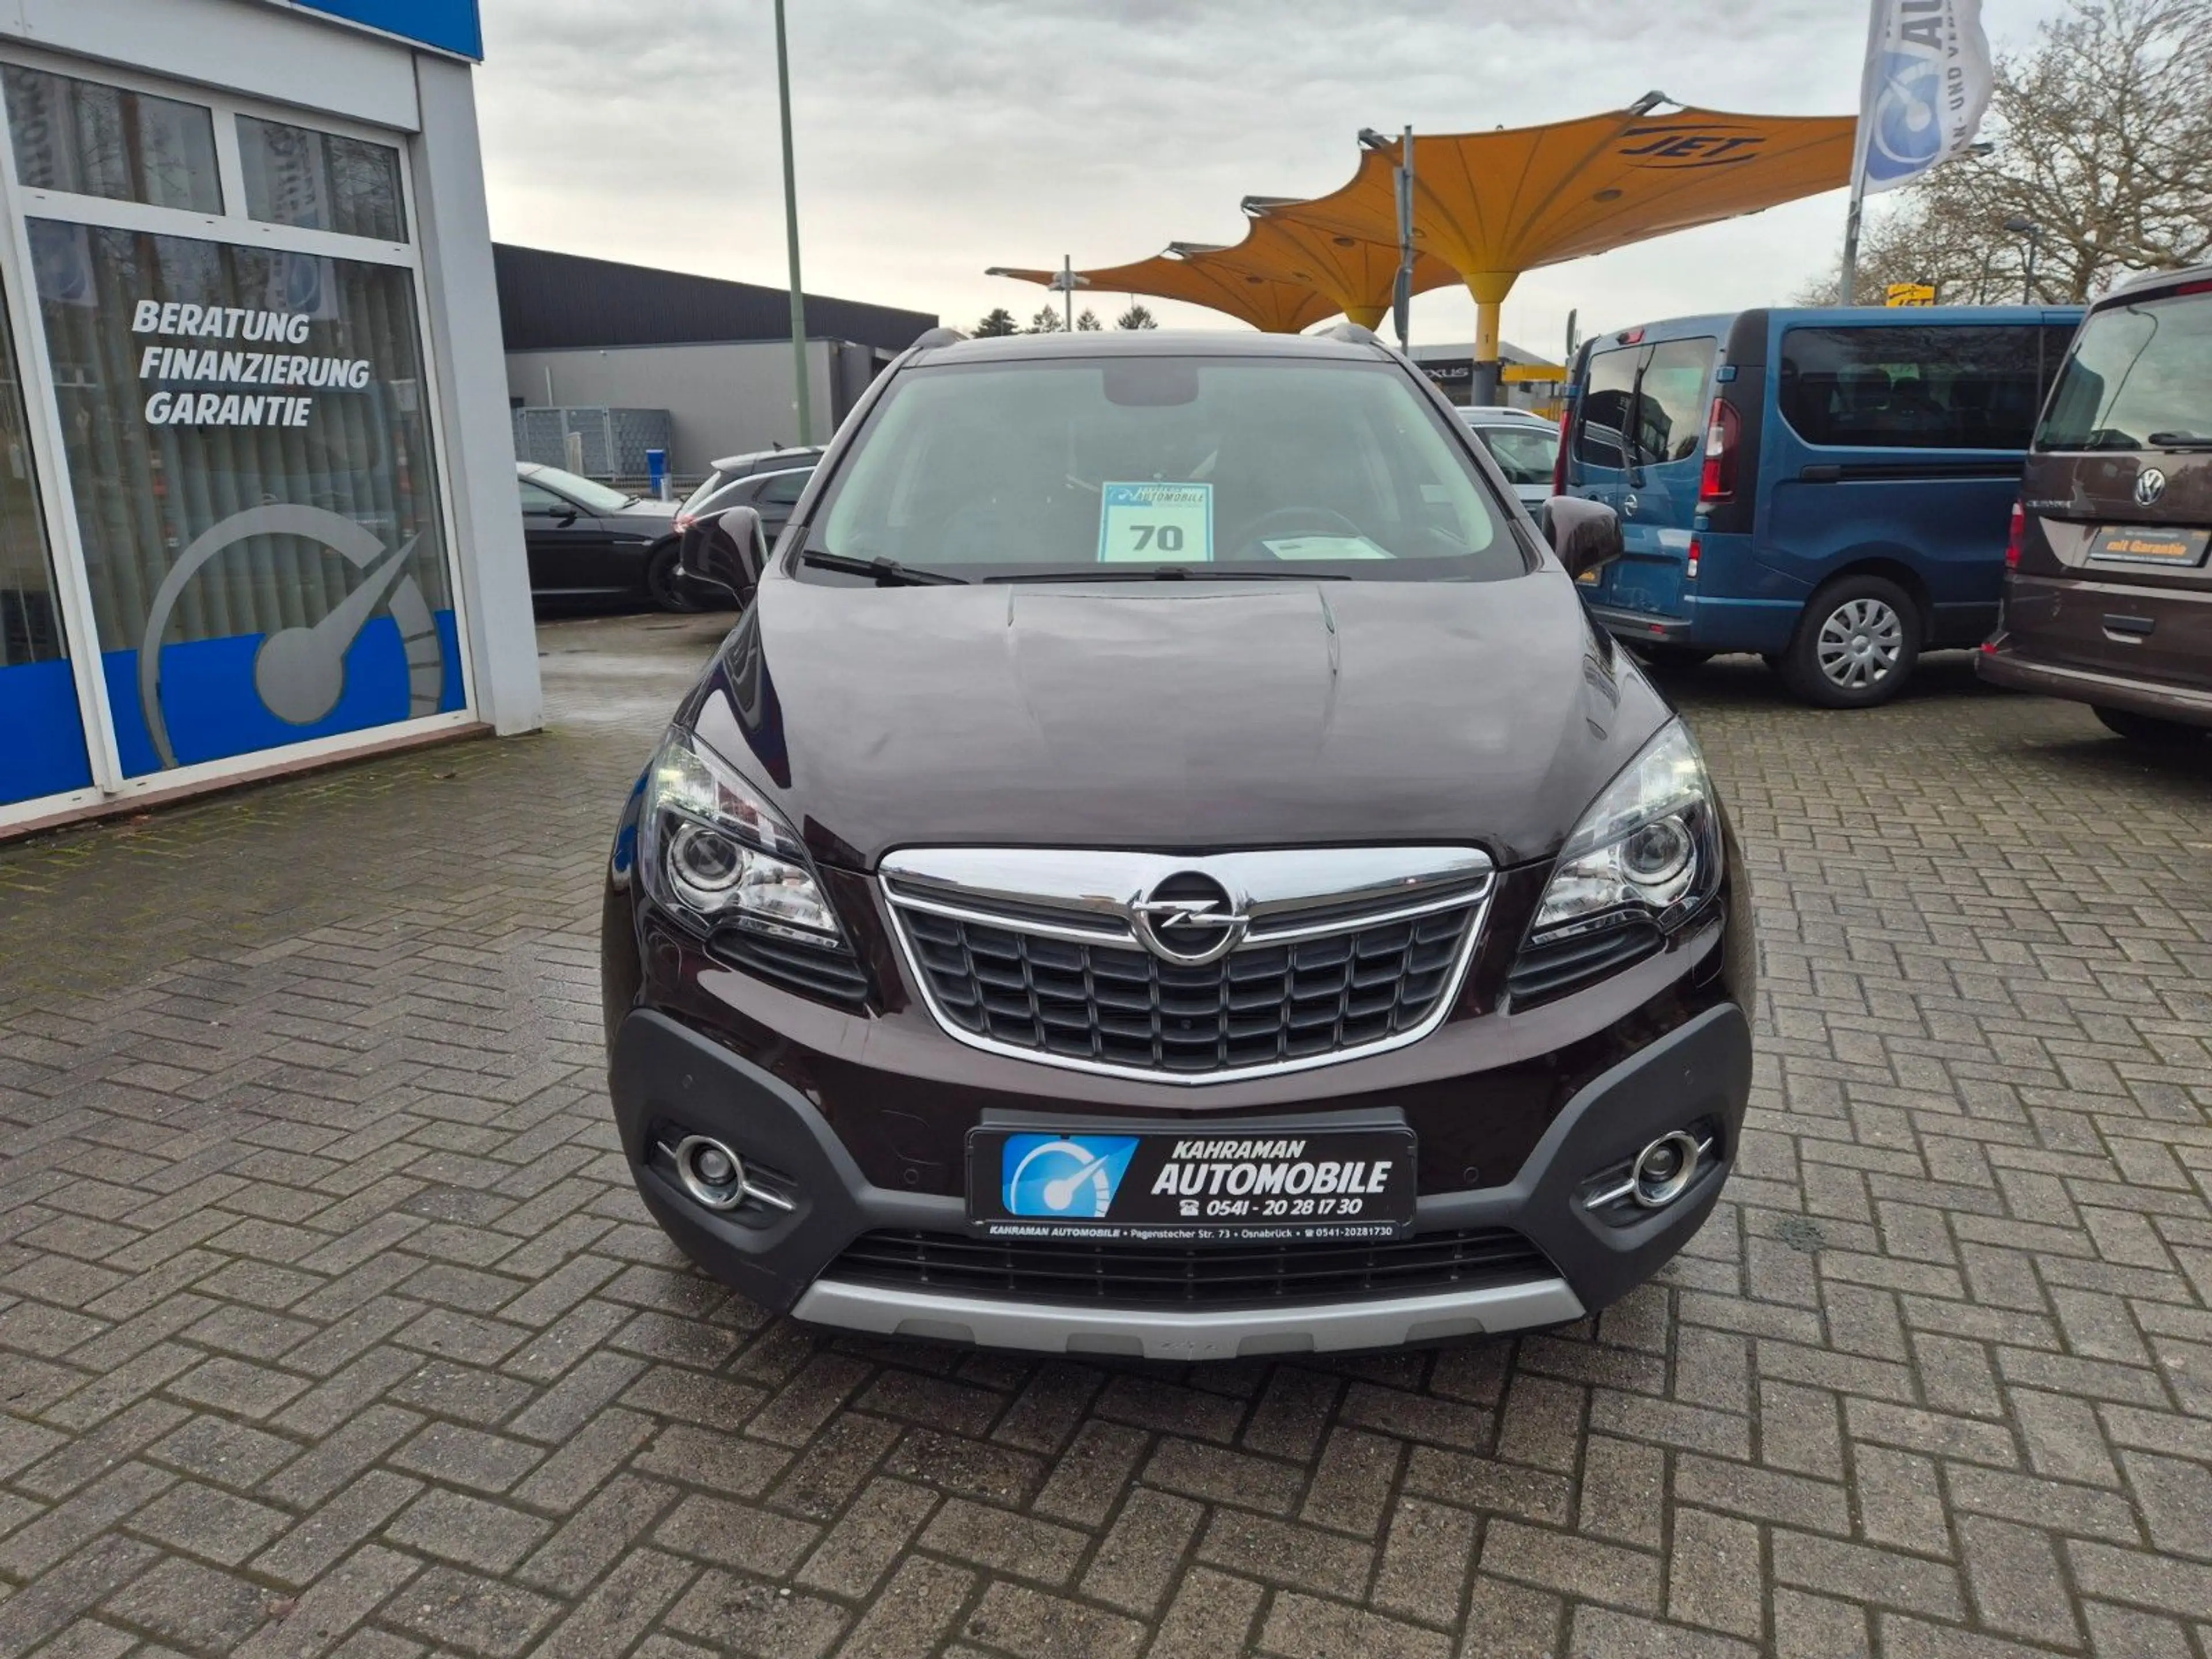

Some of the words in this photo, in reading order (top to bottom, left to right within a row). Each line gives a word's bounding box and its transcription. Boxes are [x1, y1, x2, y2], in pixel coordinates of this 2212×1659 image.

[1948, 67, 1965, 111] UND
[1618, 135, 1767, 157] JET
[132, 300, 310, 344] BERATUNG
[139, 346, 370, 389] FINANZIERUNG
[145, 391, 312, 427] GARANTIE
[1129, 525, 1184, 551] 70
[1172, 1140, 1306, 1159] KAHRAMAN
[1151, 1161, 1393, 1196] AUTOMOBILE
[1206, 1199, 1250, 1217] 0541
[1262, 1199, 1287, 1216] 20
[1290, 1199, 1315, 1215] 28
[1317, 1198, 1336, 1215] 17
[1337, 1198, 1363, 1215] 30
[990, 1225, 1050, 1236] KAHRAMAN
[1051, 1227, 1120, 1237] AUTOMOBILE
[1130, 1229, 1196, 1240] Pagenstecher
[1198, 1229, 1214, 1238] Str.
[1218, 1229, 1230, 1238] 73
[1241, 1229, 1293, 1238] Osnabrück
[1316, 1226, 1393, 1238] 0541-20281730
